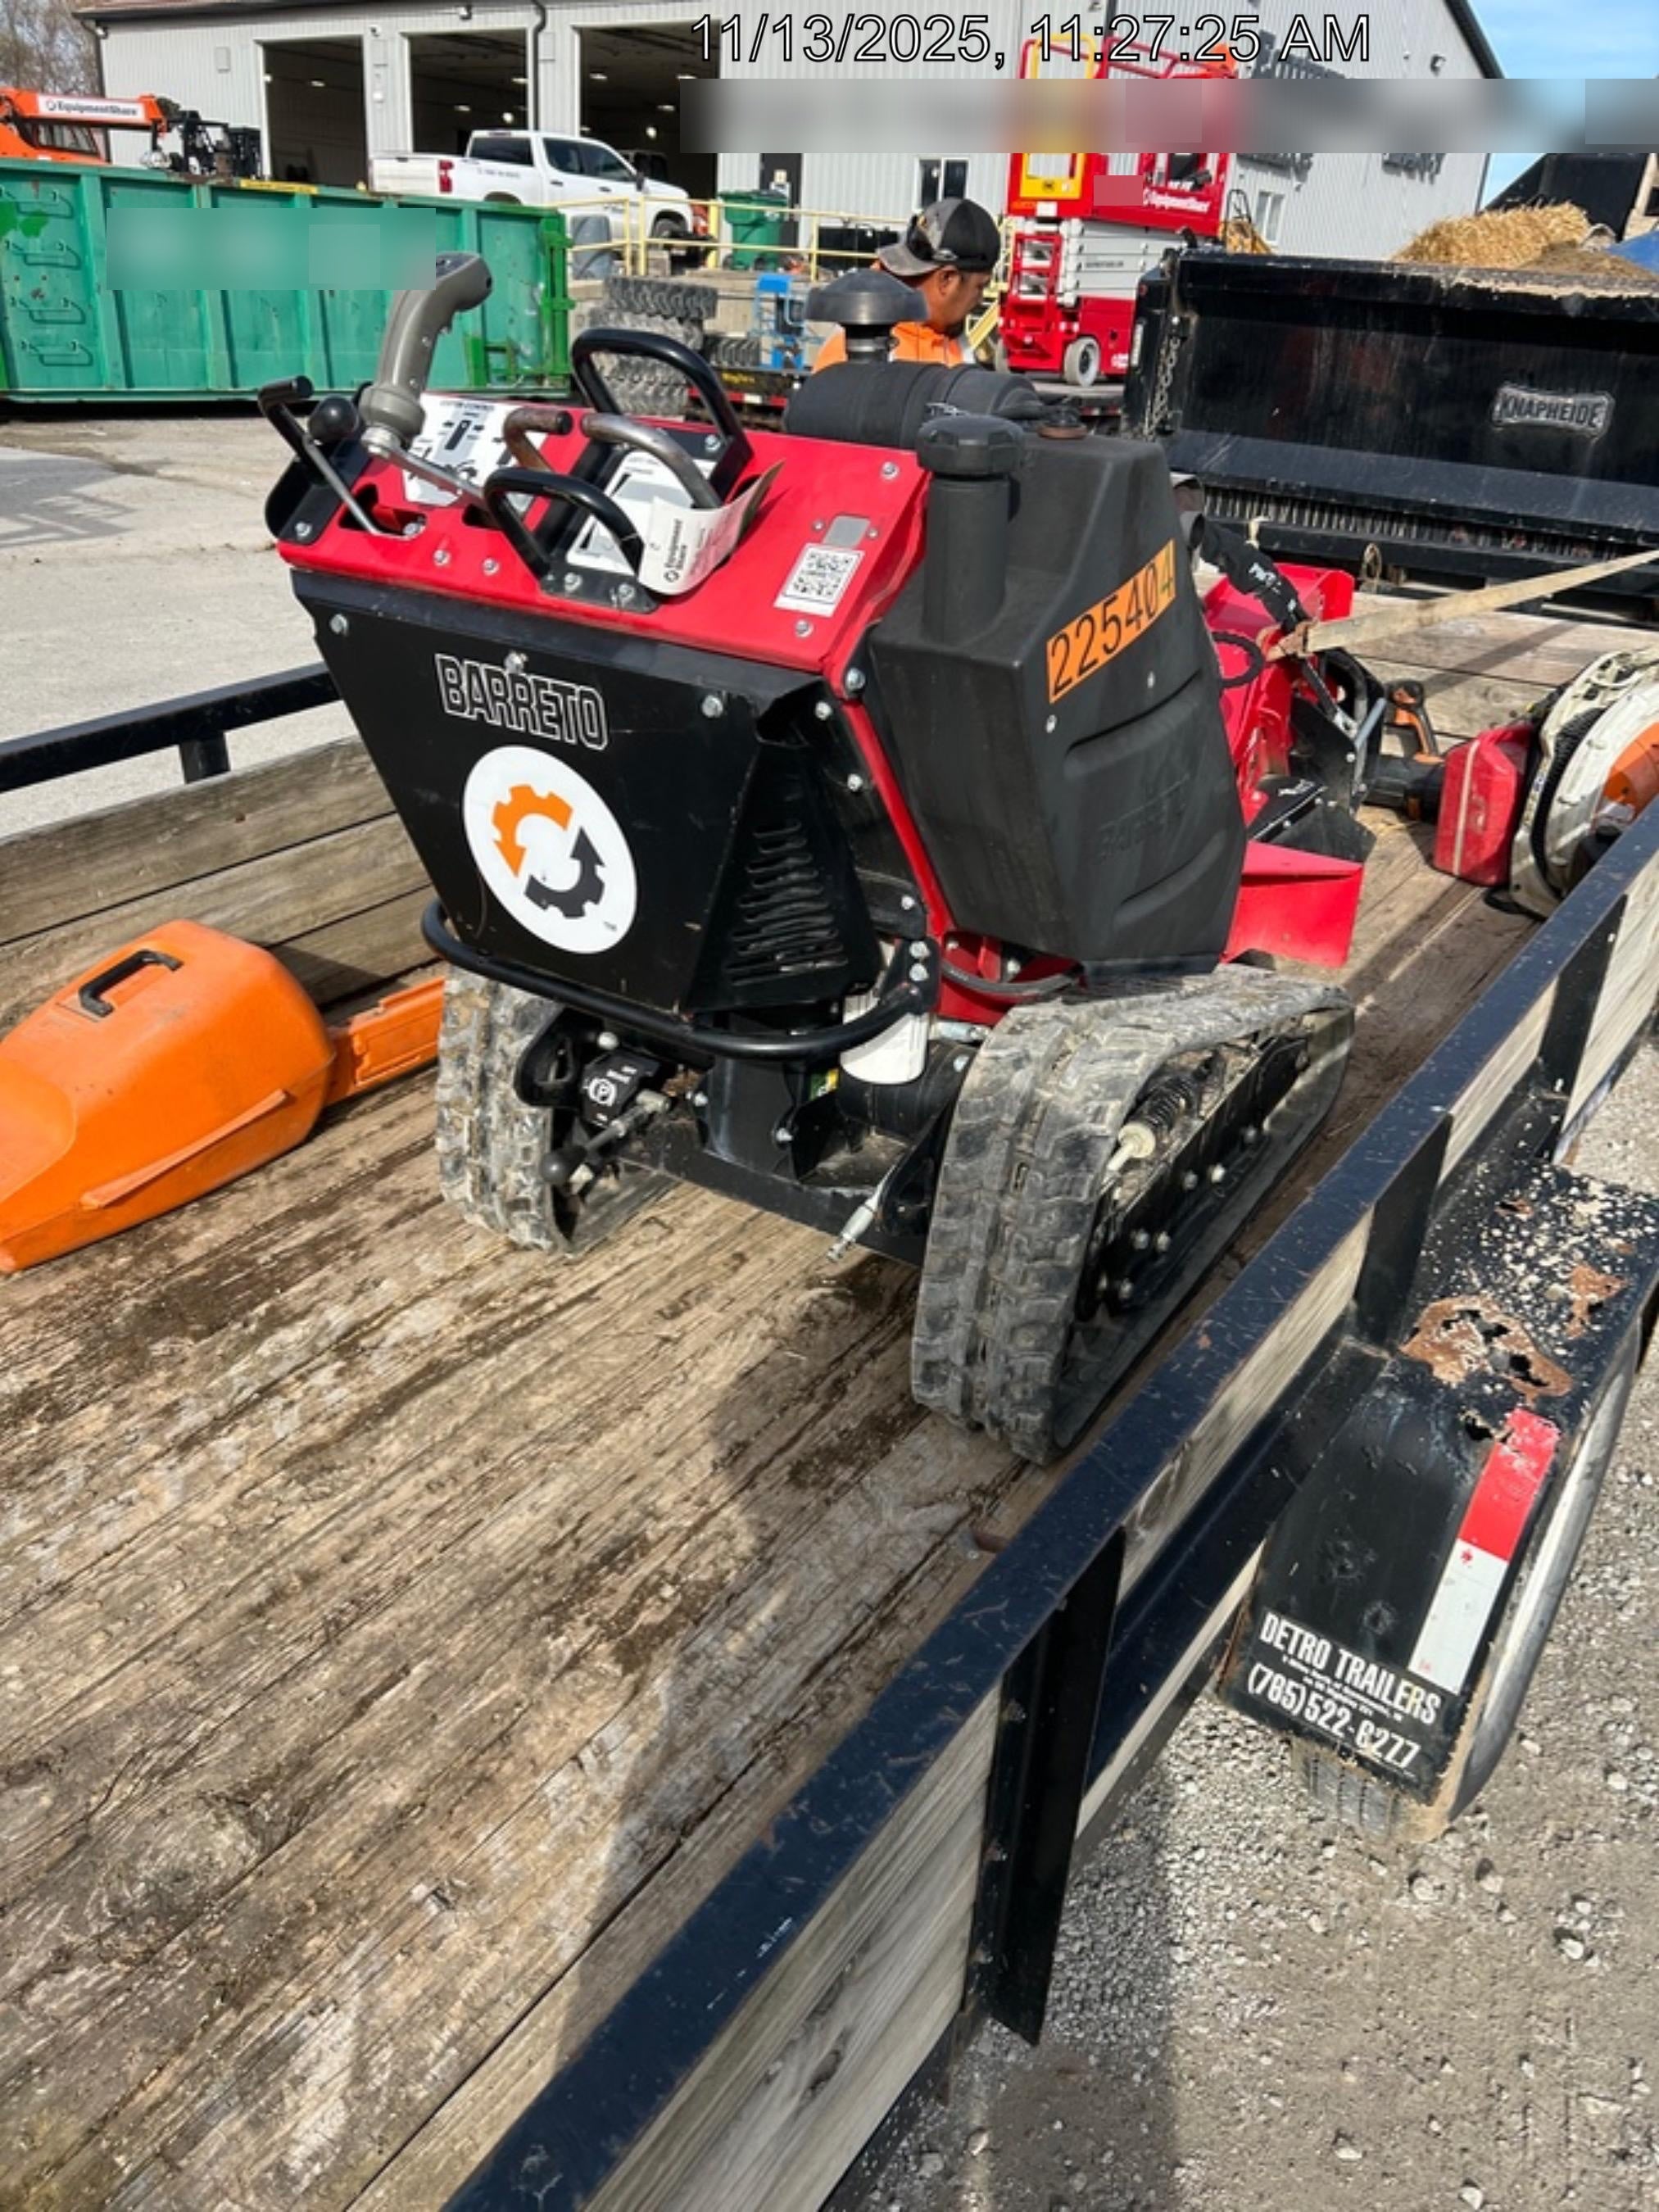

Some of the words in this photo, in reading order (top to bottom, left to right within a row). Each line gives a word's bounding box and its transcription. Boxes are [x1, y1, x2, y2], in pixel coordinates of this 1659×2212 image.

[1497, 393, 1603, 428] KNAPHEIDE
[1051, 544, 1174, 696] 225404
[434, 652, 609, 750] BARRETO
[1259, 1612, 1332, 1669] DETRO
[1334, 1647, 1442, 1725] TRAILERS
